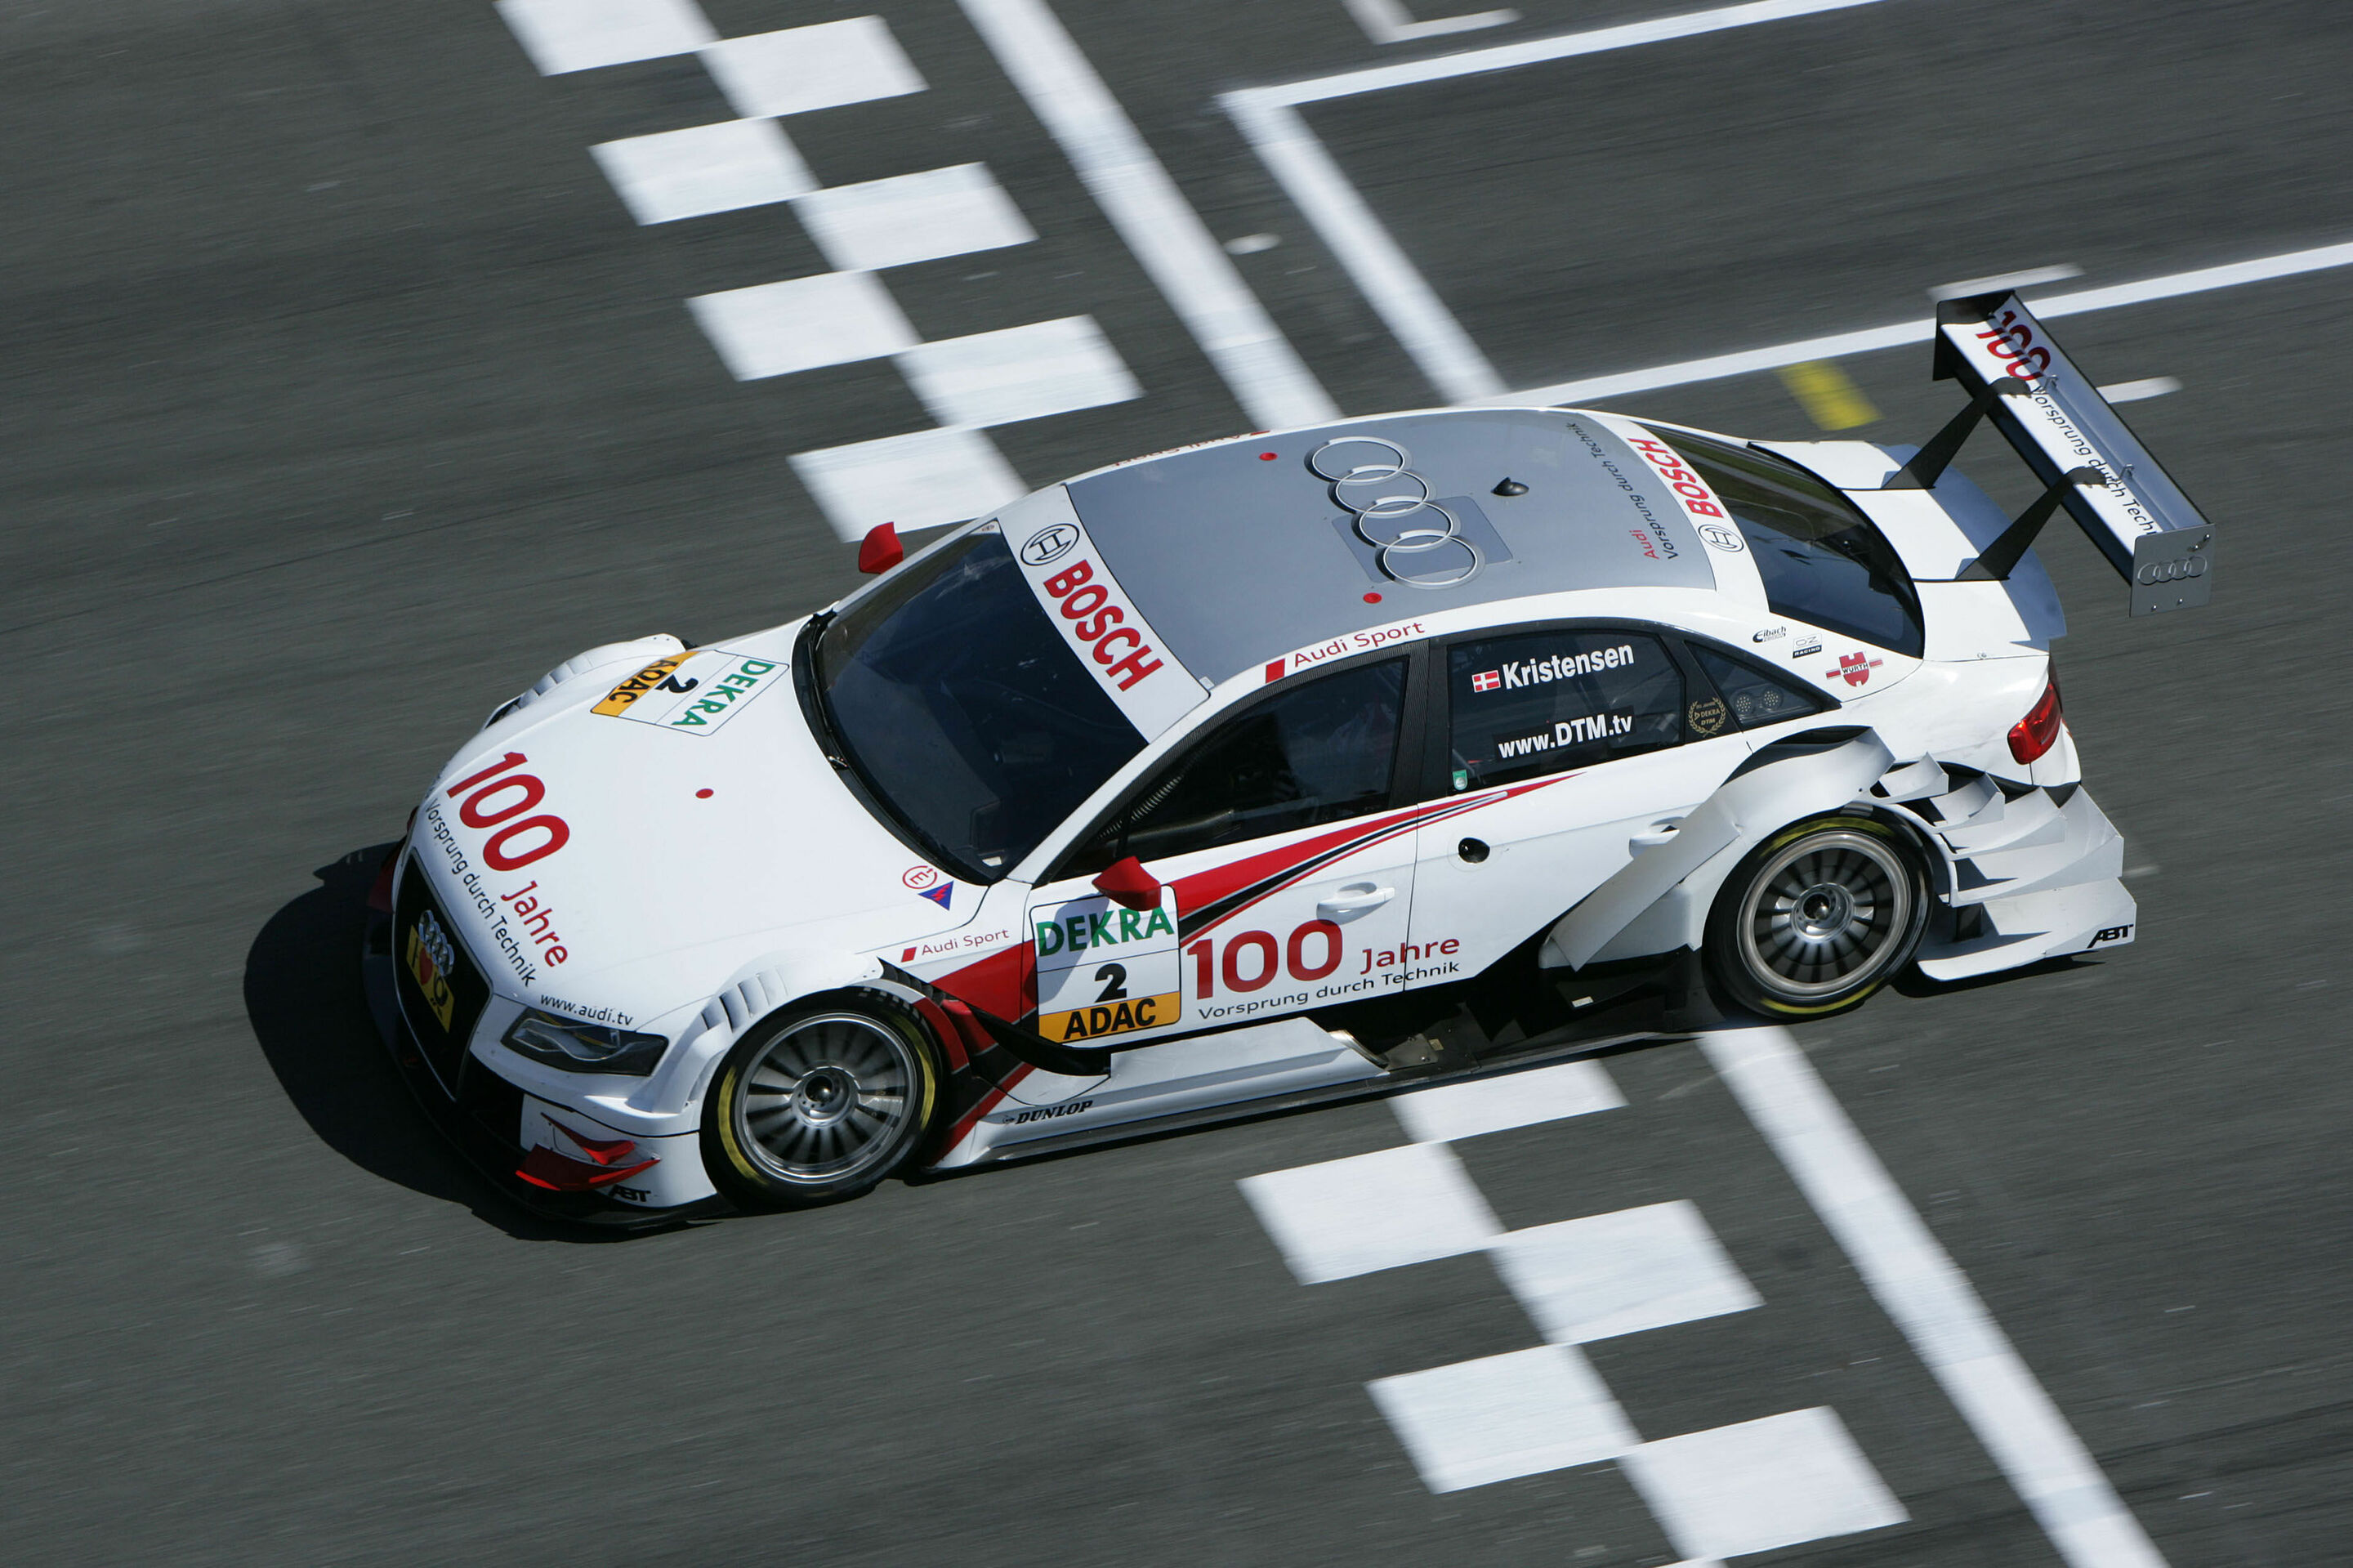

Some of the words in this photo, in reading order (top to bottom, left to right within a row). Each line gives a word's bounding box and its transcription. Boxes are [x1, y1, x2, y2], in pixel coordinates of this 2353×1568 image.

[1976, 310, 2051, 381] 100
[1566, 422, 1605, 458] Technik
[2030, 385, 2092, 455] Vorsprung
[1601, 460, 1633, 492] durch
[1627, 438, 1724, 519] BOSCH
[1628, 529, 1659, 560] Audi
[1629, 494, 1678, 560] Vorsprung
[1043, 559, 1164, 692] BOSCH
[1294, 639, 1348, 668] Audi
[1354, 622, 1426, 647] Sport
[608, 659, 680, 704] ADAC
[654, 674, 699, 694] 2
[1502, 644, 1634, 690] Kristensen
[671, 659, 777, 726] DEKRA
[1498, 713, 1632, 758] www.DTM.tv
[446, 751, 570, 872] 100
[424, 797, 469, 876] Vorsprung
[462, 871, 496, 919] durch
[490, 915, 537, 987] Technik
[500, 880, 569, 967] Jahre
[921, 937, 958, 956] Audi
[962, 928, 1010, 949] Sport
[1035, 905, 1176, 958] DEKRA
[2086, 923, 2134, 949] ABT
[1186, 918, 1343, 1000] 100
[1360, 938, 1461, 976] Jahre
[1093, 963, 1127, 1003] 2
[1198, 990, 1310, 1020] Vorsprung
[1315, 978, 1375, 998] durch
[1381, 961, 1461, 986] Technik
[539, 993, 634, 1027] www.audi.tv
[1062, 998, 1157, 1040] ADAC
[1015, 1100, 1094, 1124] DUNLOP
[608, 1184, 652, 1202] ABT
